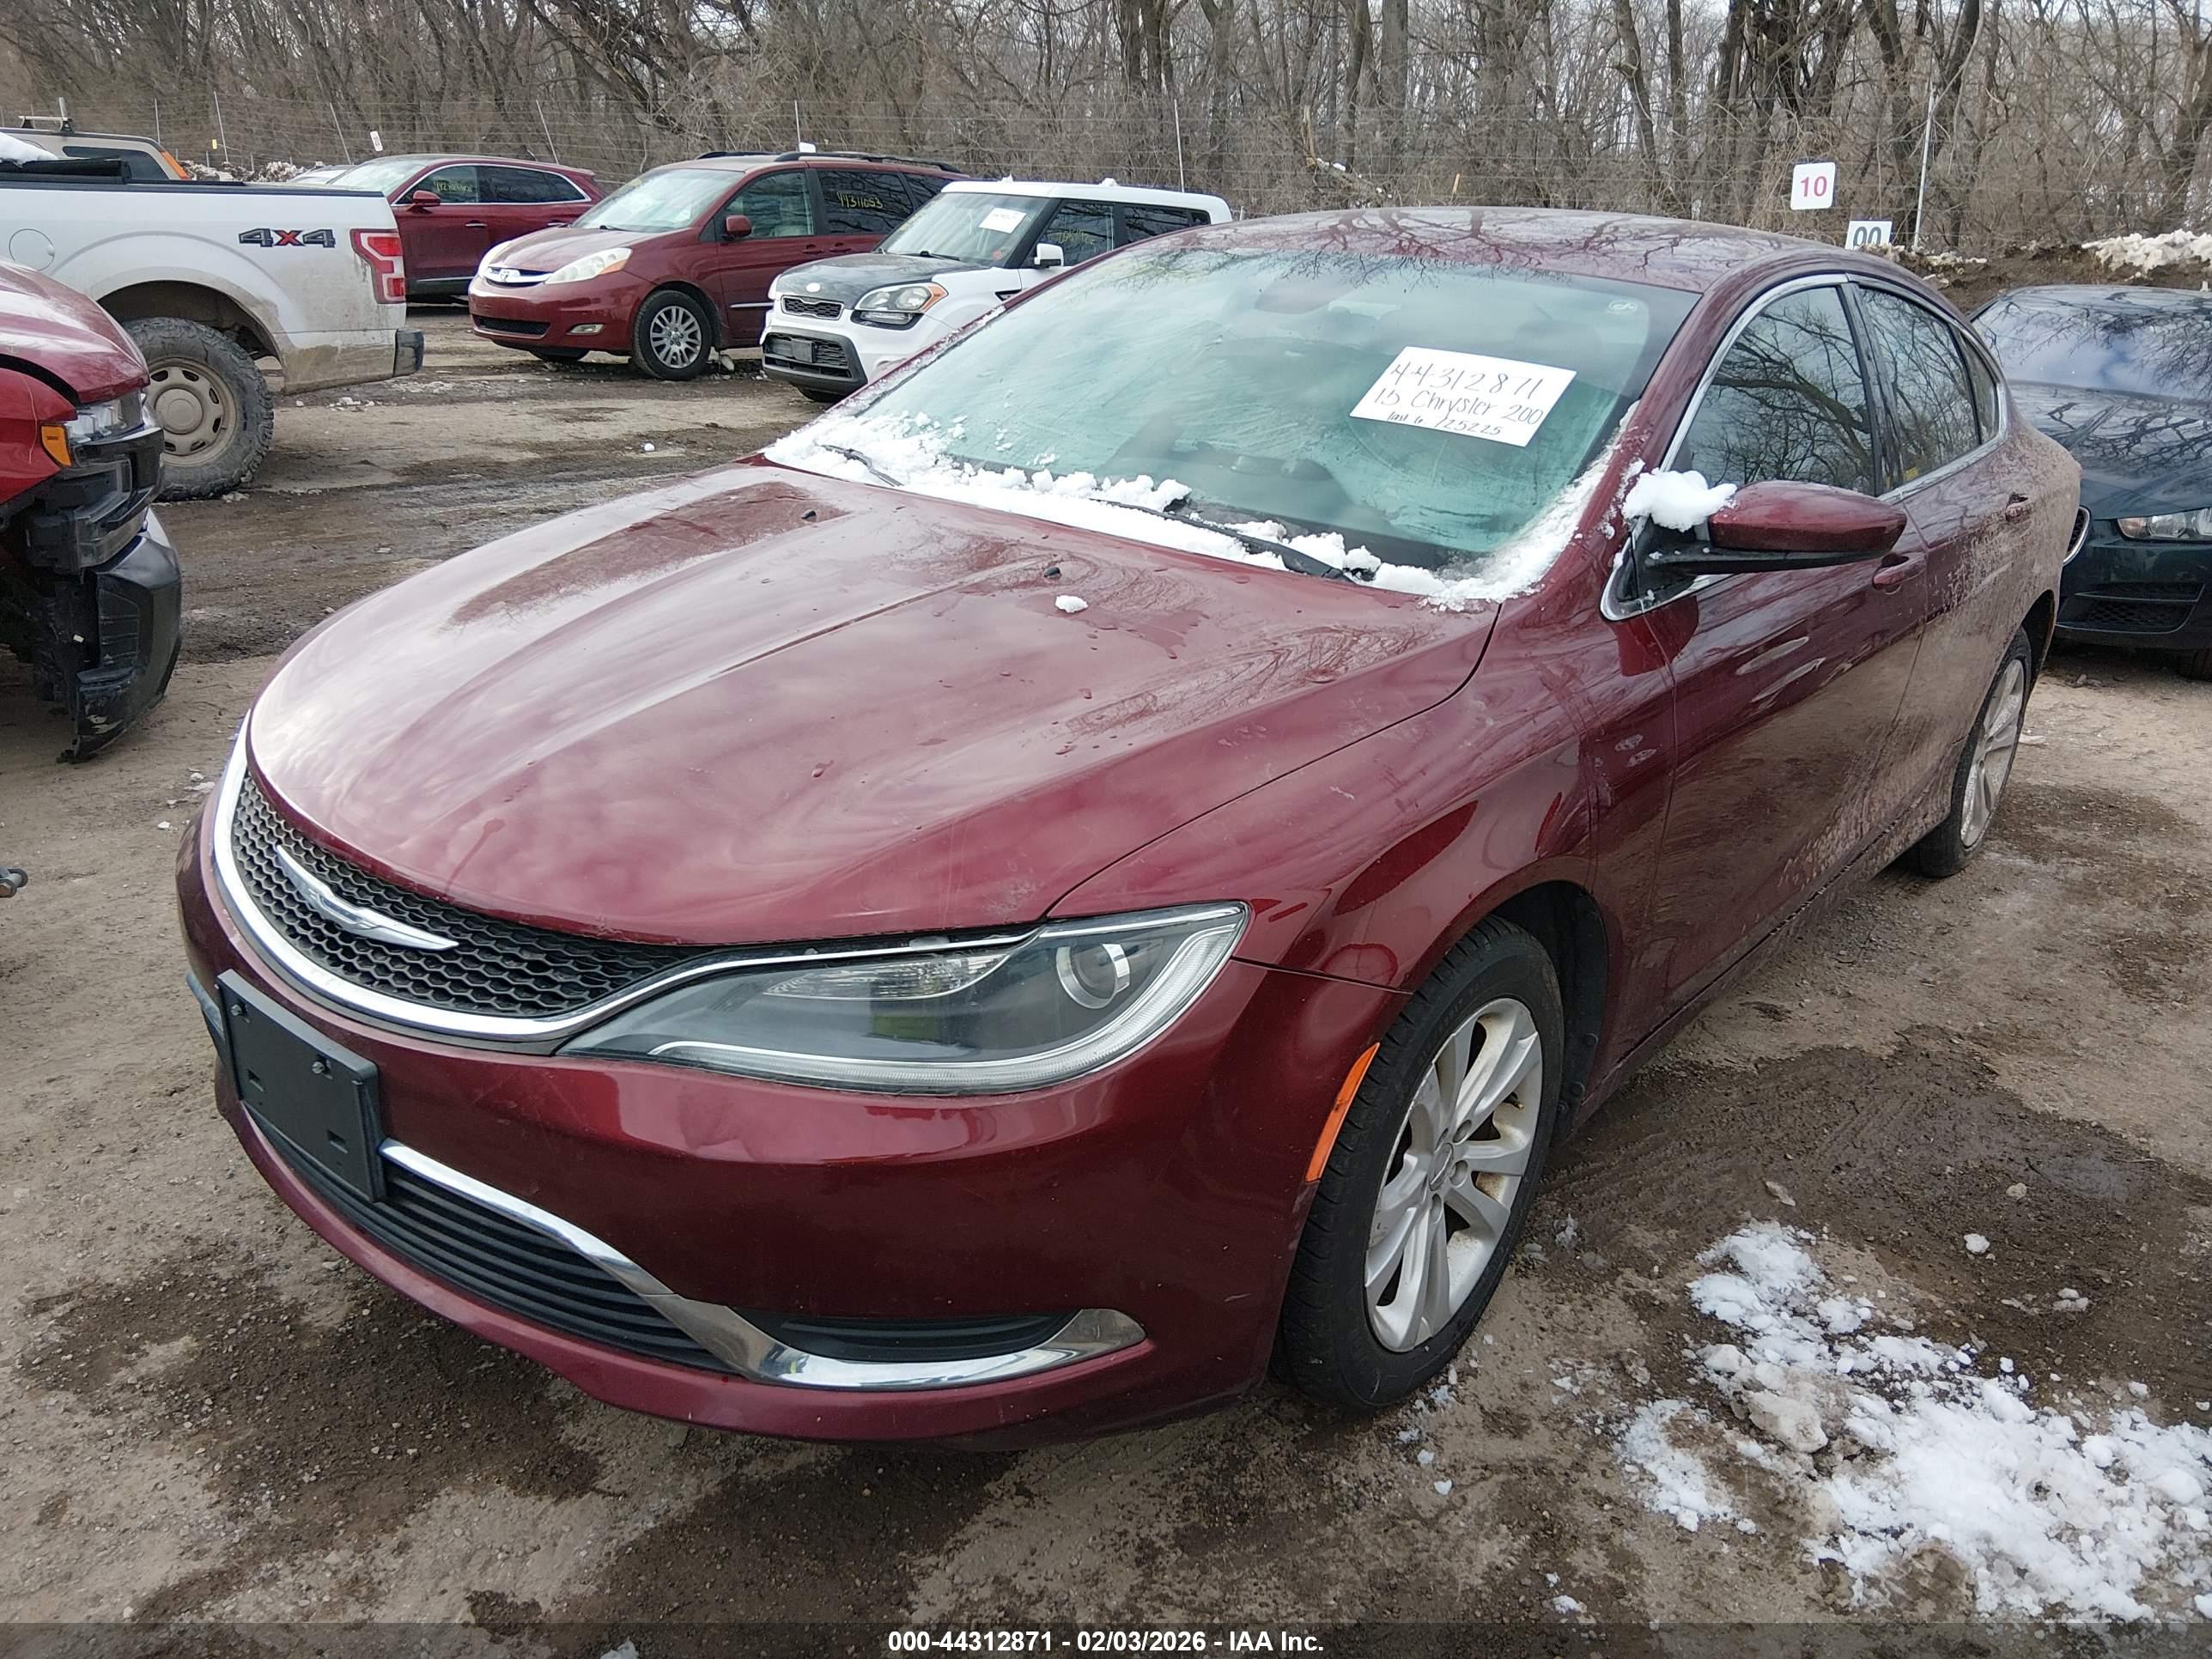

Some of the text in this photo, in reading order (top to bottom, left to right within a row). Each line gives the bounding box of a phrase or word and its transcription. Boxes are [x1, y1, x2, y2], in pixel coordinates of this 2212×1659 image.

[1801, 175, 1828, 198] 10
[1390, 362, 1544, 399] 44312871
[1411, 390, 1498, 418] Chrysler
[1500, 404, 1544, 425] 200
